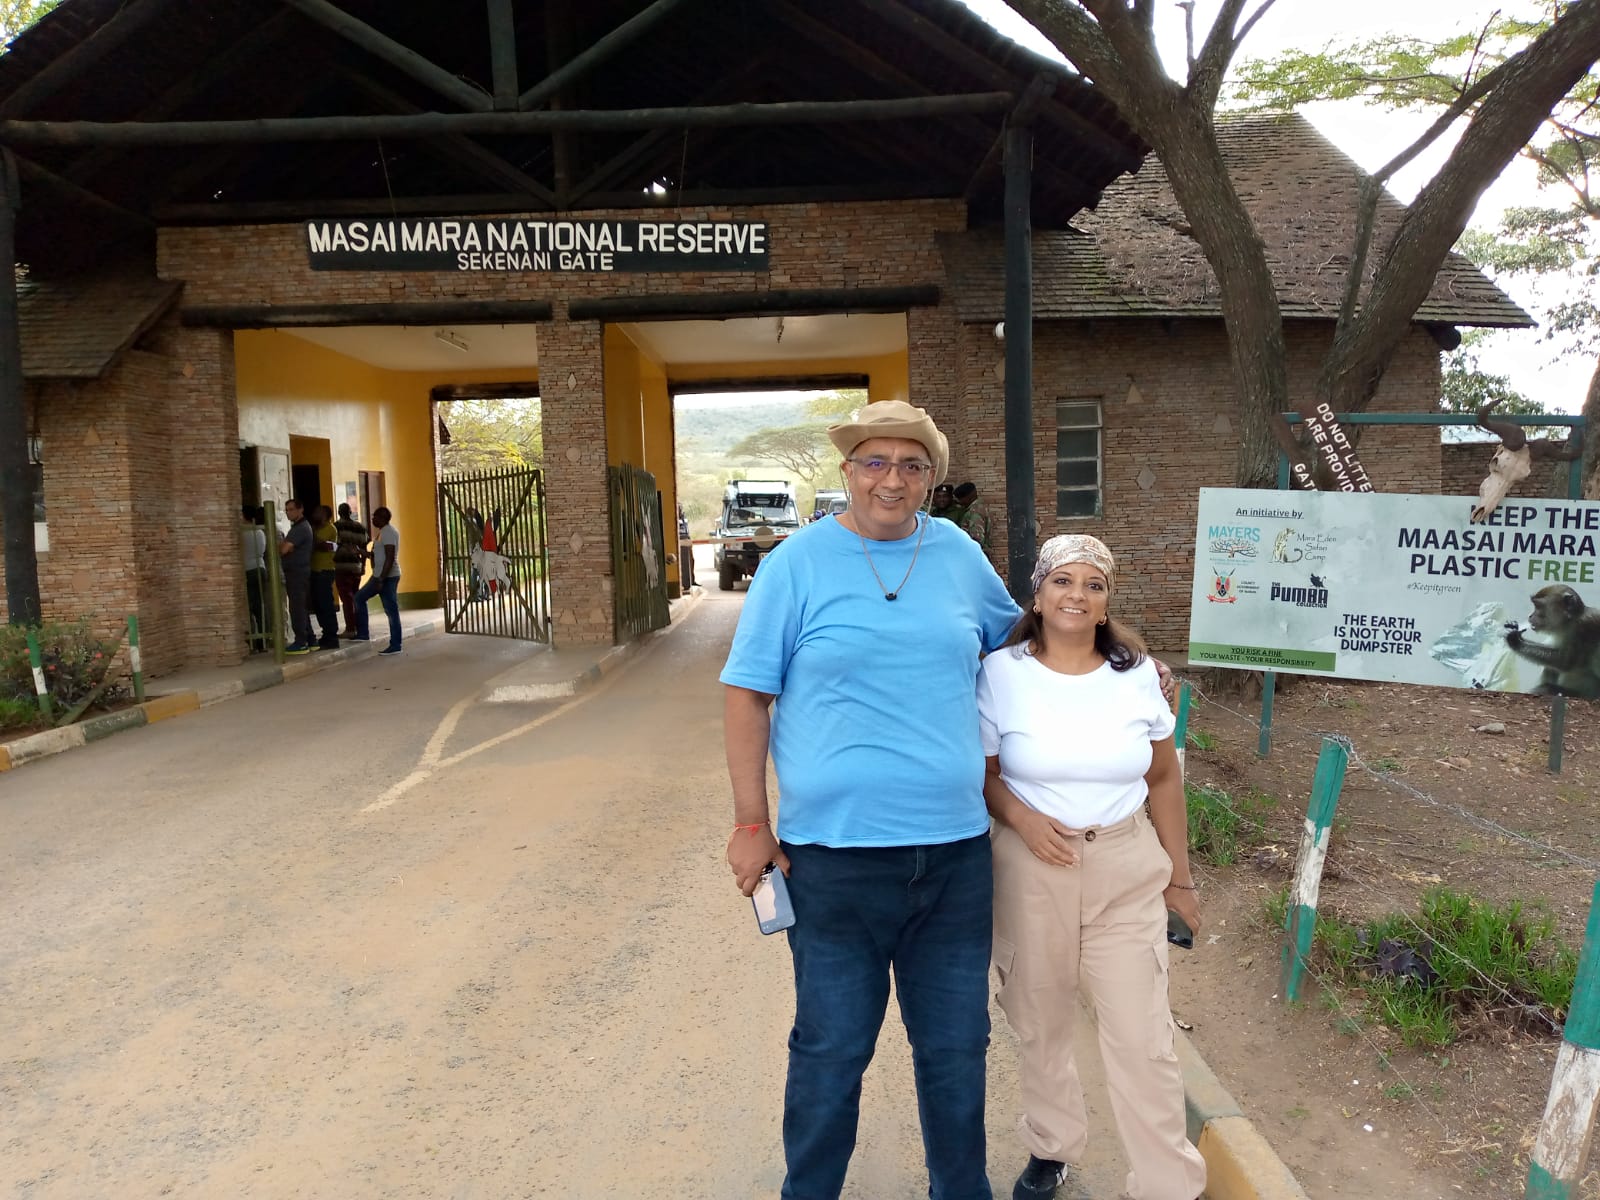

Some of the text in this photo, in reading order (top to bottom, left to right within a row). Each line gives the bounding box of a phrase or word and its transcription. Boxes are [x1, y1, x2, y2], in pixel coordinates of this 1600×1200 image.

[308, 221, 765, 254] MASAI MARA NATIONAL RESERVE
[457, 252, 614, 271] SEKENANI GATE
[1305, 417, 1328, 443] ARE
[1316, 402, 1375, 493] DO NOT LITTE
[1294, 463, 1318, 492] GAT
[1235, 507, 1303, 520] An initiative by
[1544, 506, 1599, 530] THE
[1208, 525, 1261, 543] MAYERS
[1296, 533, 1316, 542] Mara
[1397, 527, 1597, 557] MAASAI MARA
[1410, 553, 1596, 583] PLASTIC FREE
[1270, 586, 1328, 604] PUMBA
[1342, 613, 1415, 630] THE EARTH
[1334, 625, 1422, 643] IS NOT YOUR
[1231, 647, 1246, 655] YOU
[1246, 648, 1260, 656] RISK
[1268, 650, 1282, 658] FINE
[1340, 638, 1413, 655] DUMPSTER
[1199, 651, 1218, 659] YOUR
[1218, 653, 1240, 661] WASTE
[1245, 655, 1264, 663] YOUR
[1264, 656, 1316, 667] RESPONSIBILITY
